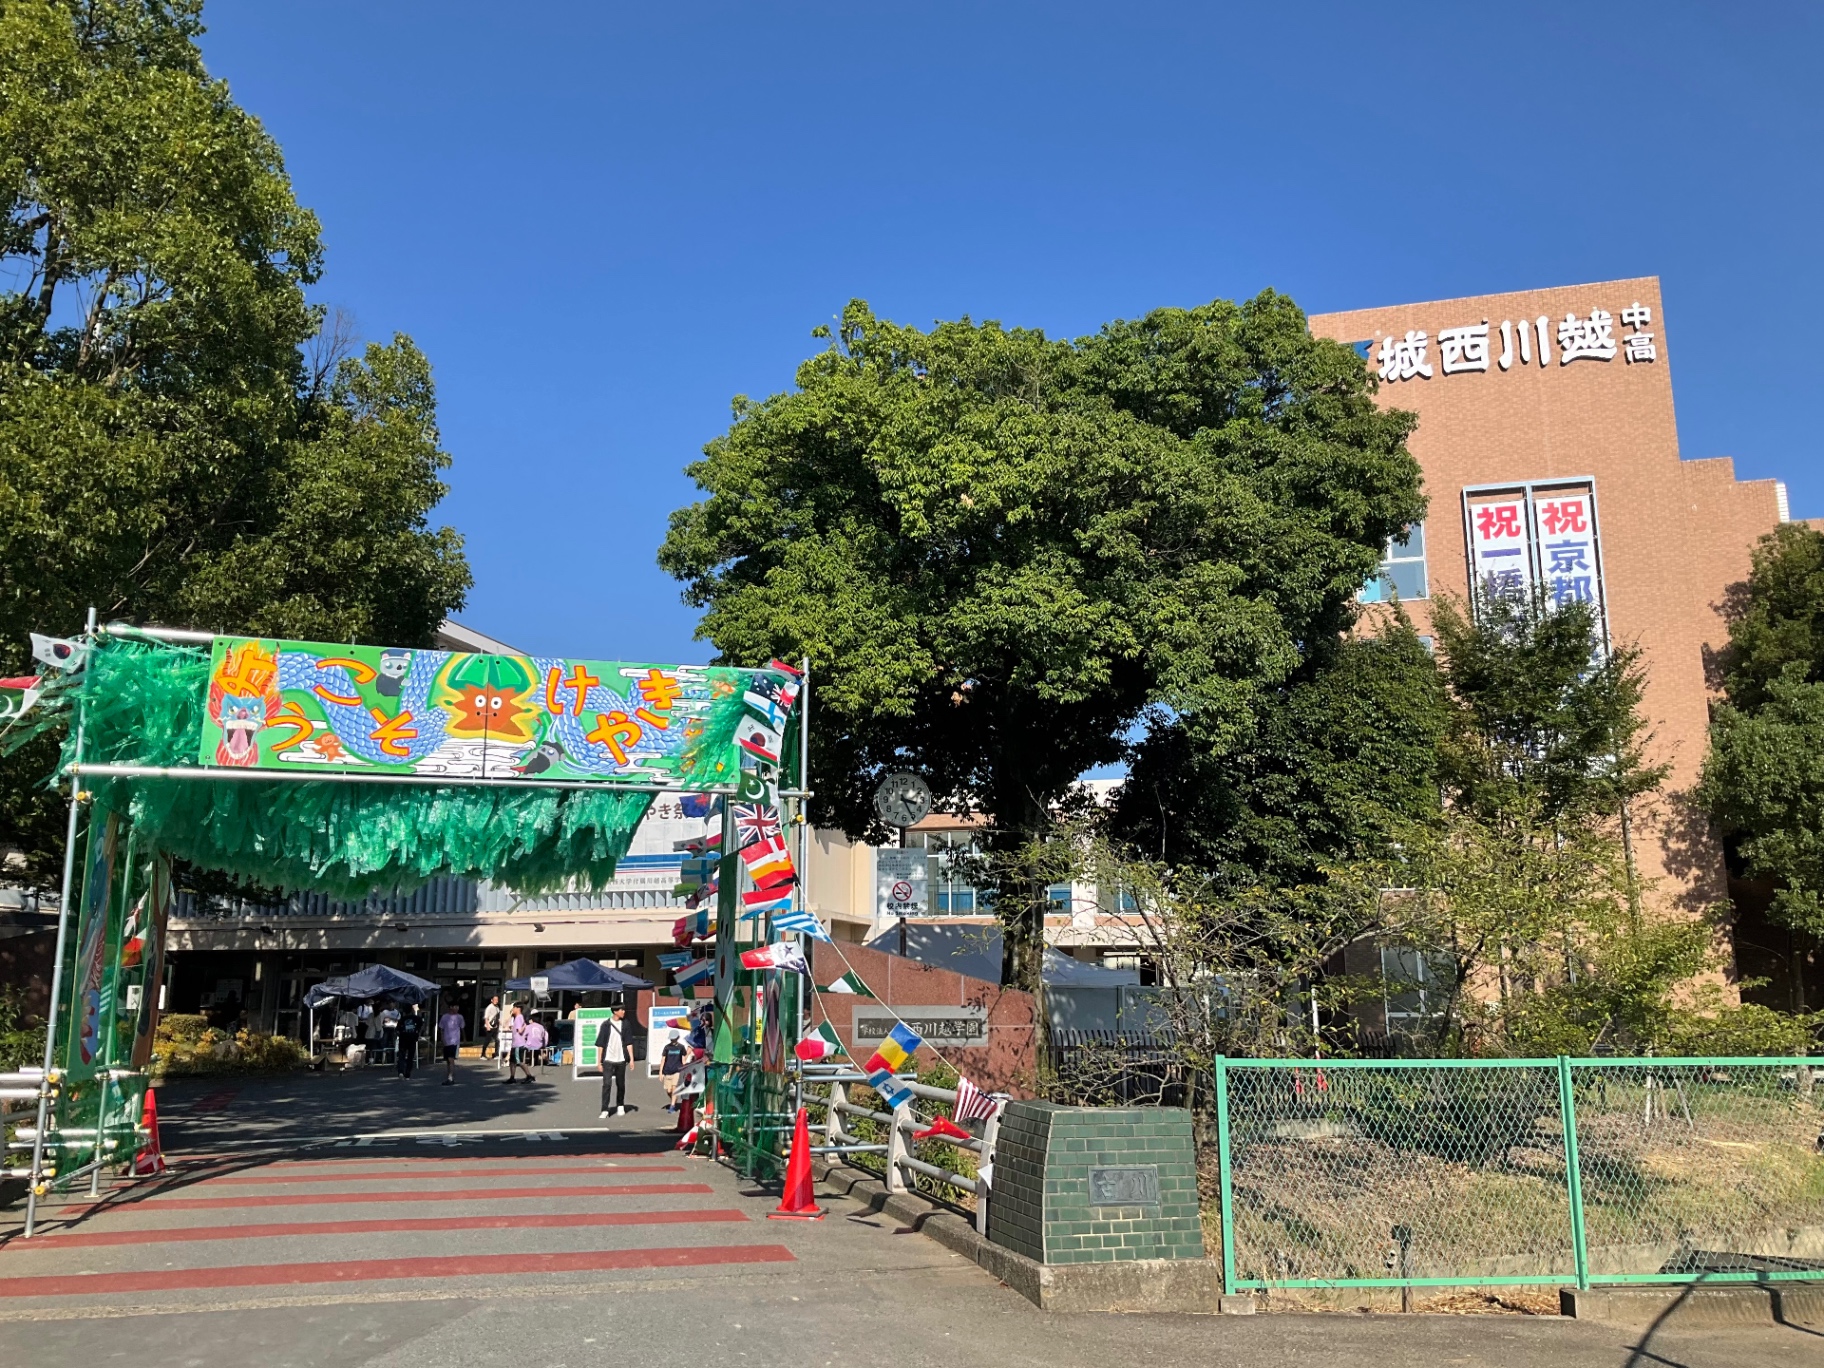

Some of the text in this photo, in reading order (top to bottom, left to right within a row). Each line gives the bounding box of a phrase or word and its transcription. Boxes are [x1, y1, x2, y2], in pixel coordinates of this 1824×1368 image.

[1377, 302, 1657, 380] 城西川越 中高
[215, 649, 418, 756] ようこそ
[545, 665, 706, 778] けやき
[905, 1021, 979, 1037] 西川越学園
